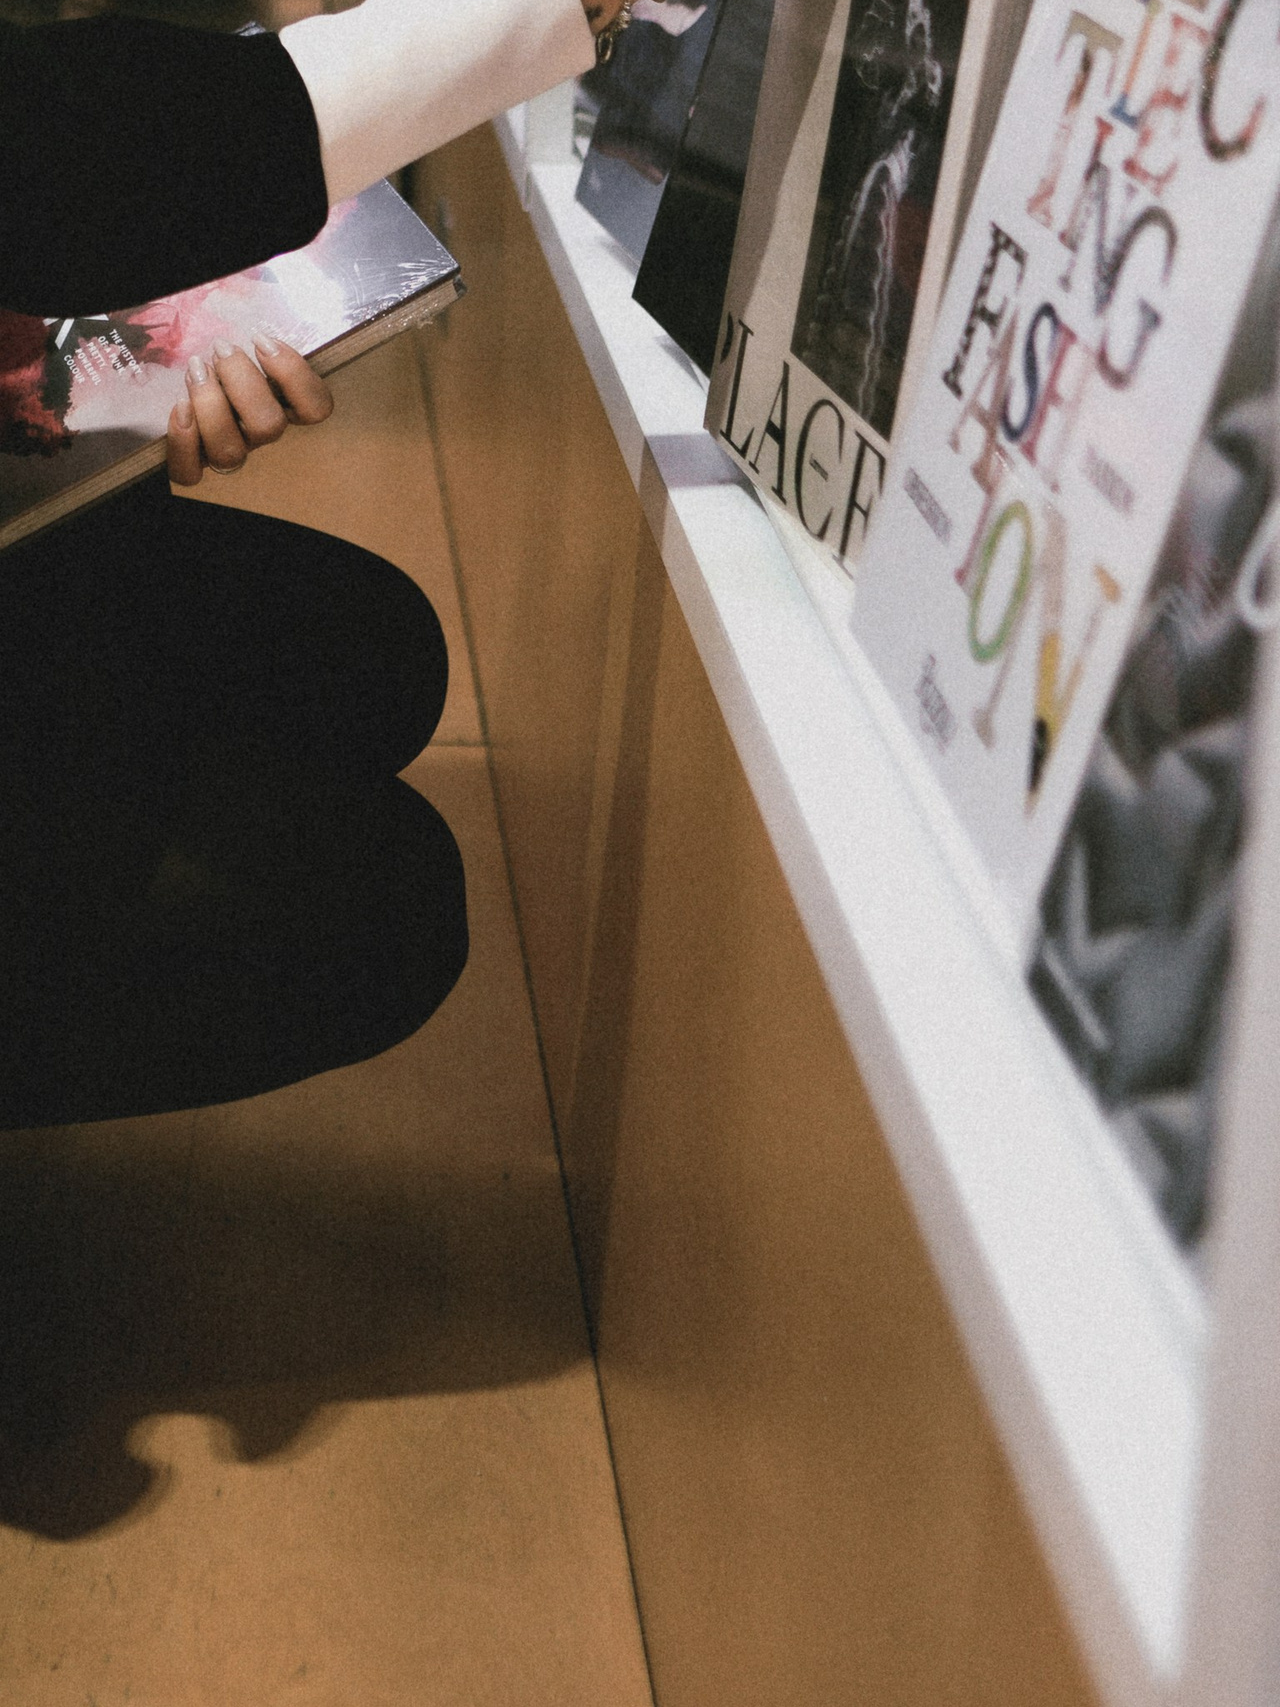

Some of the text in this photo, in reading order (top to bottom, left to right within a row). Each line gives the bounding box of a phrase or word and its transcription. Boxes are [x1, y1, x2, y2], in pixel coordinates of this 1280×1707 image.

[97, 335, 110, 349] OF
[109, 329, 144, 375] THE HISTORY
[63, 354, 86, 384] COLOUR
[75, 348, 102, 386] POWERFUL
[719, 311, 887, 580] LACE
